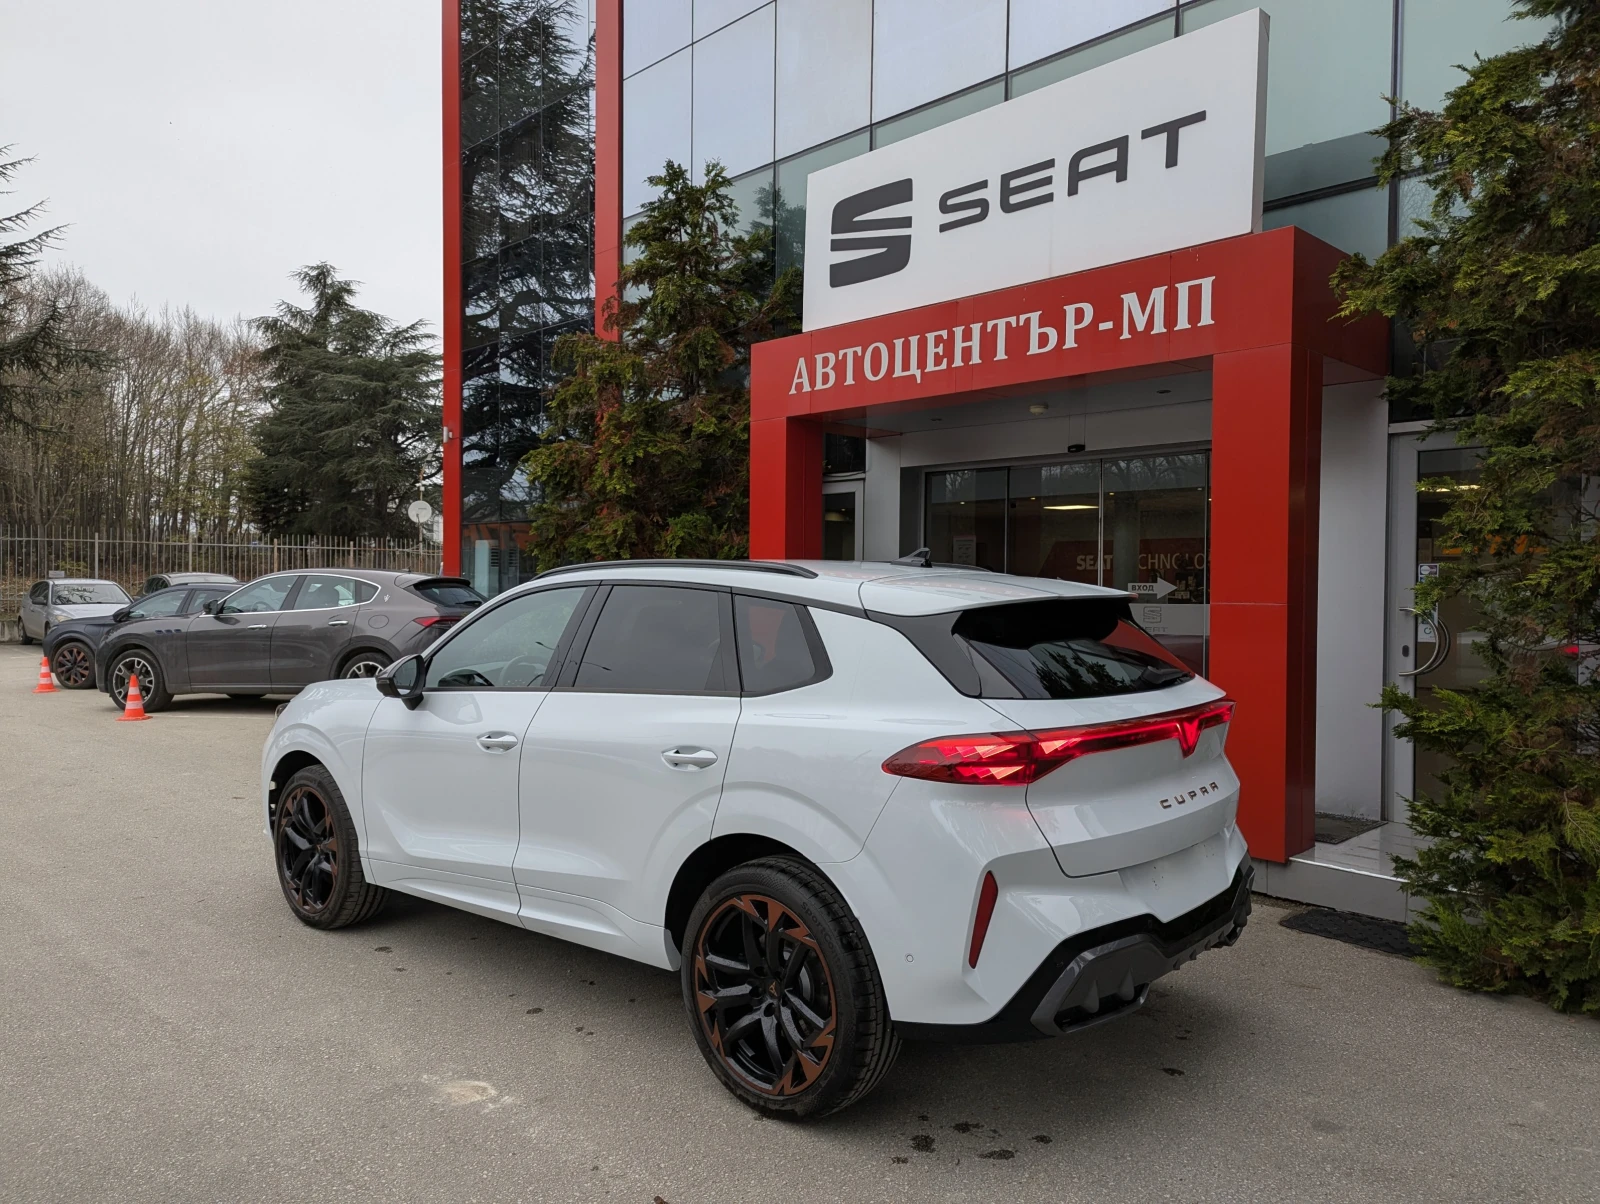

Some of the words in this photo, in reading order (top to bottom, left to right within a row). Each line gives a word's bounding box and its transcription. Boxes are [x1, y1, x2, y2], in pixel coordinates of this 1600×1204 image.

[938, 109, 1207, 233] SEAT
[788, 275, 1216, 396] АВТОЦЕНТЪР-МП
[1131, 584, 1155, 593] ВХОД
[1159, 781, 1219, 810] CUPRA
